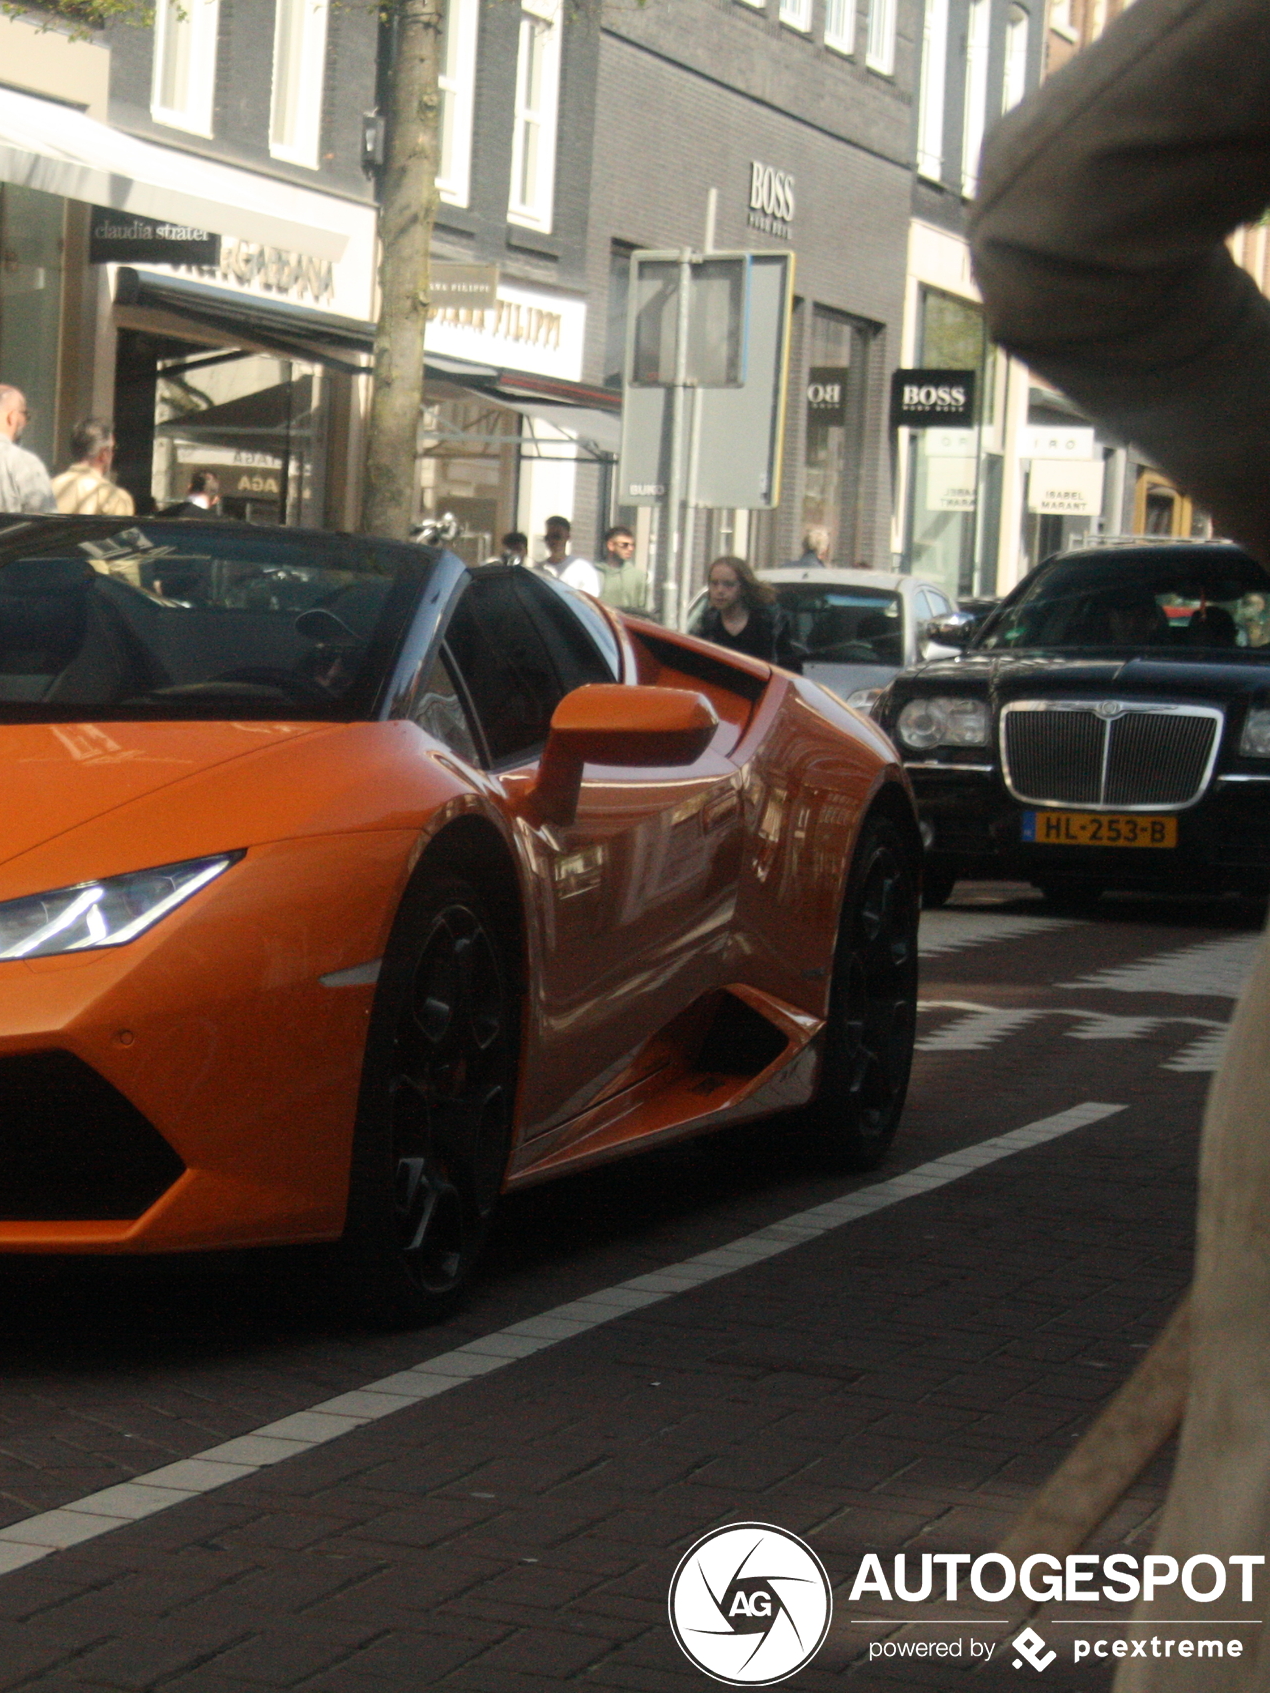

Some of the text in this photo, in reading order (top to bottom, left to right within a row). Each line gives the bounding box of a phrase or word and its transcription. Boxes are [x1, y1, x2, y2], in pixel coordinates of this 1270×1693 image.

[750, 160, 795, 222] BOSS
[94, 220, 153, 240] claudia
[903, 384, 966, 406] BOSS
[1041, 501, 1088, 511] MARANT
[1045, 490, 1085, 501] ISABEL
[1045, 817, 1166, 843] HL-253-B
